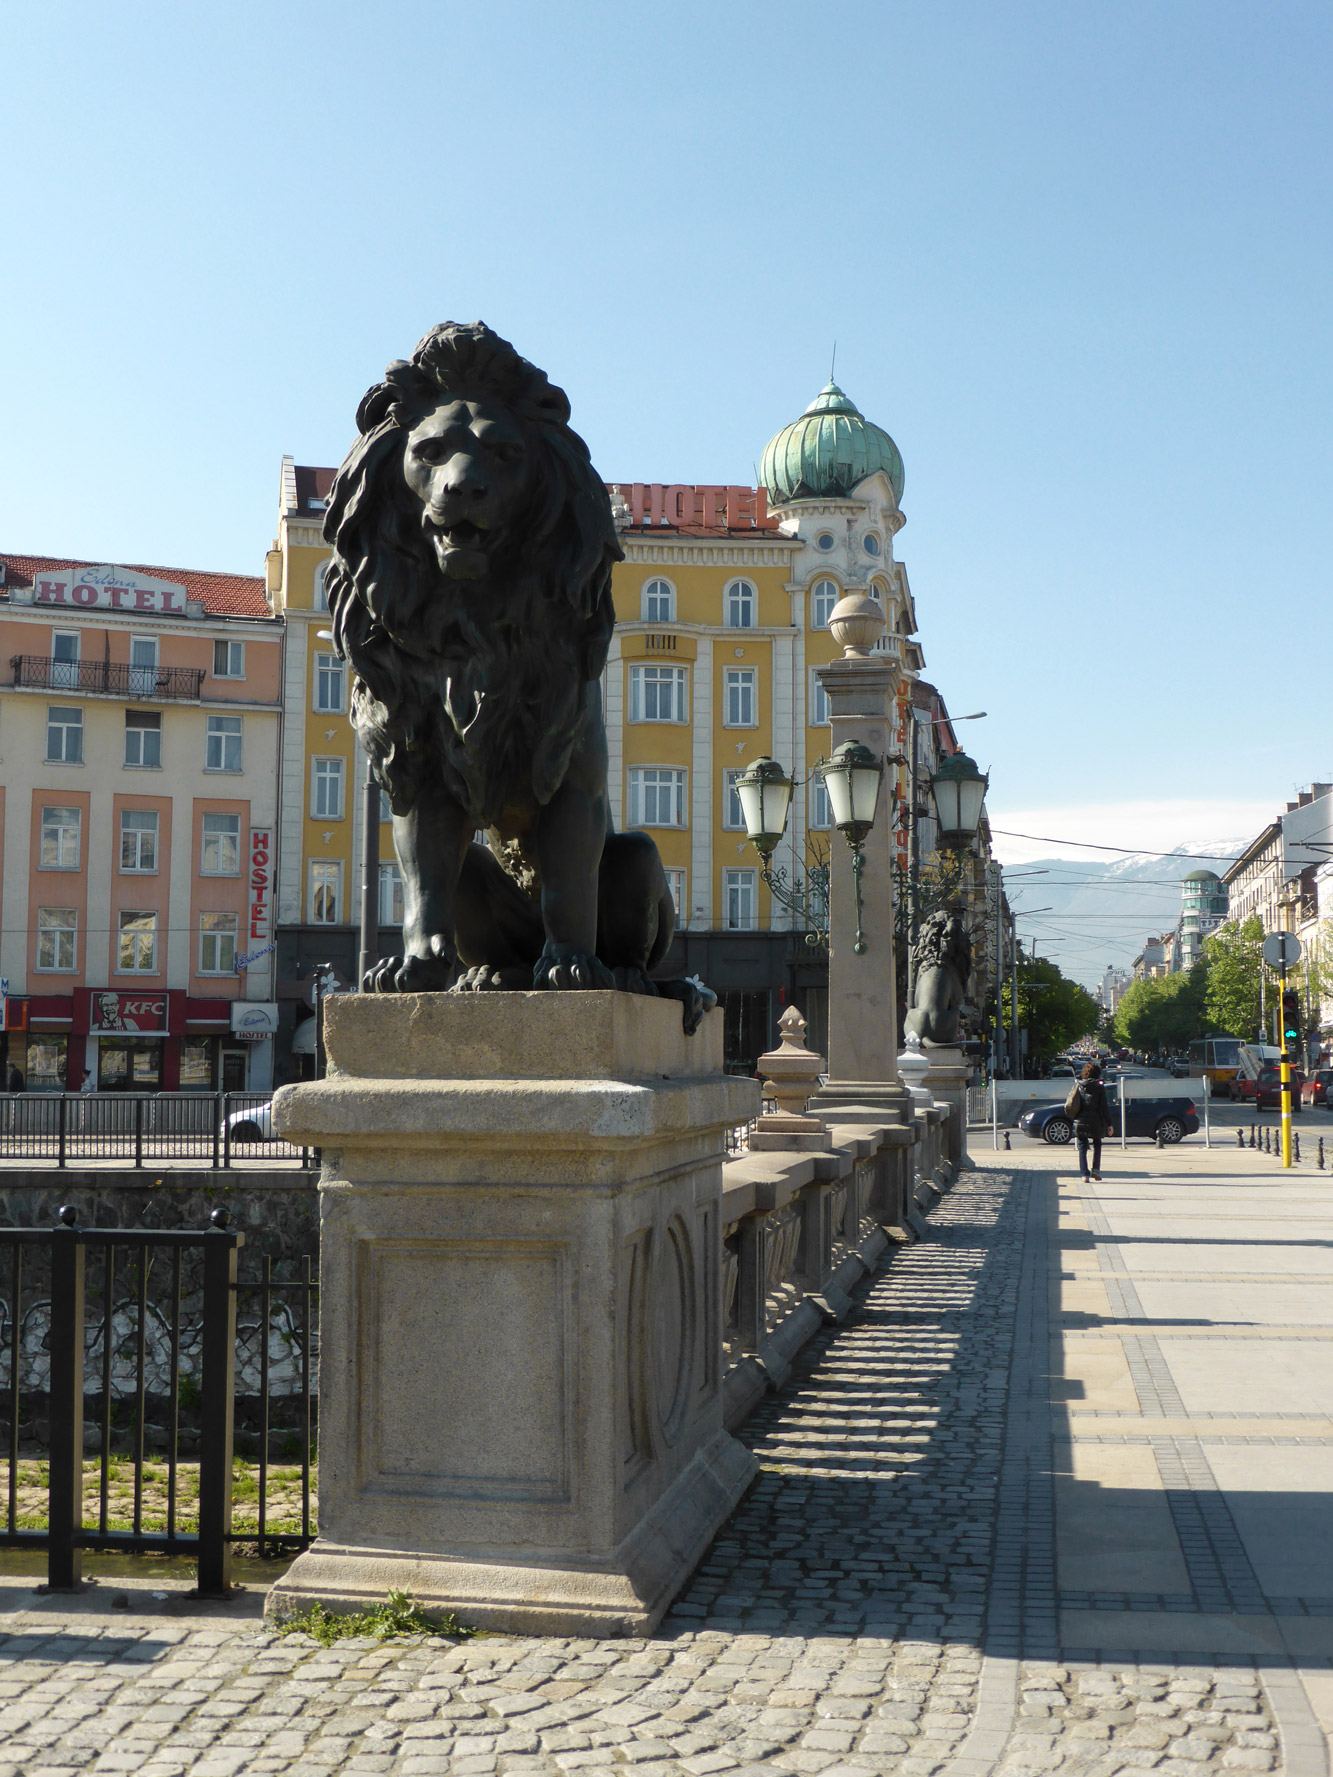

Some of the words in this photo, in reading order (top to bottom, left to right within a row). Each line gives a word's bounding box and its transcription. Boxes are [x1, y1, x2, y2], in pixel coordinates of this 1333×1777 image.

[632, 483, 779, 530] HOTEL
[38, 581, 182, 613] HOTEL
[250, 833, 269, 939] HOSTEL
[123, 1001, 165, 1015] KFC
